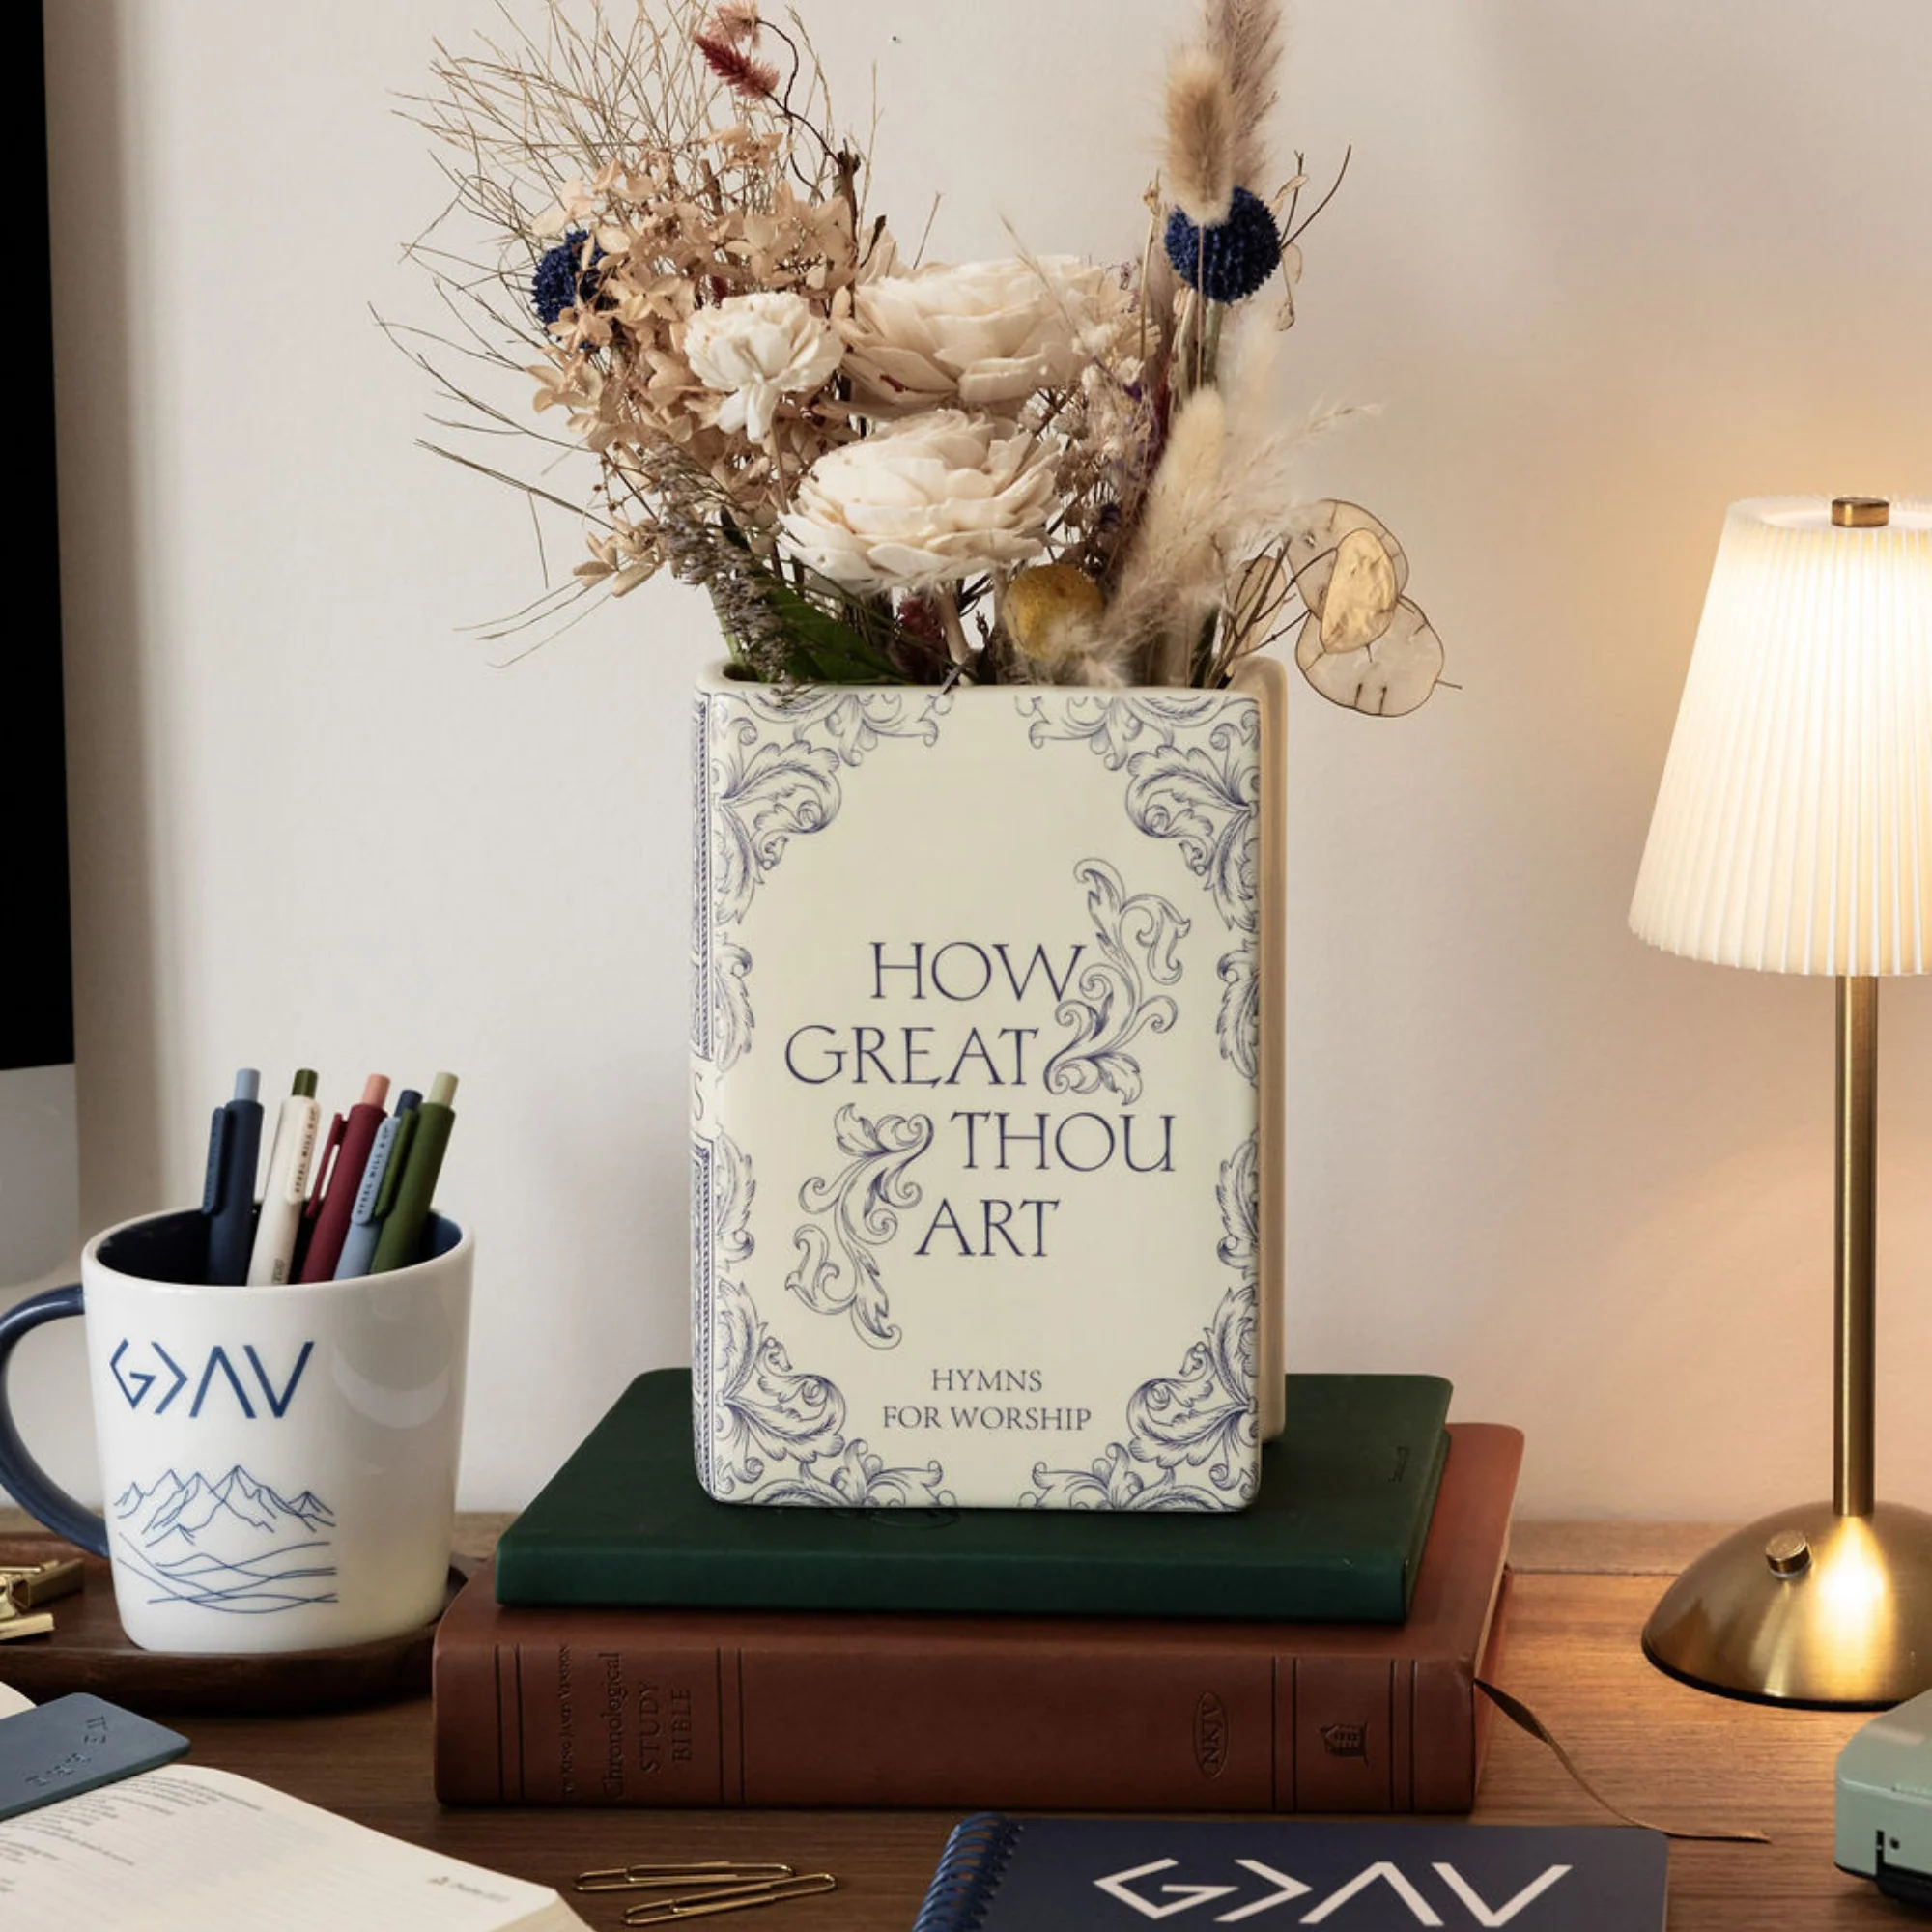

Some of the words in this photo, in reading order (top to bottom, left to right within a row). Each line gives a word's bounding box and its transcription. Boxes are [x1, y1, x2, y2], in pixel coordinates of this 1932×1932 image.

[870, 941, 1086, 1003] HOW
[784, 1024, 1040, 1089] GREAT
[951, 1111, 1176, 1173] THOU
[913, 1197, 1060, 1258] ART
[933, 1368, 1043, 1393] HYMNS
[883, 1406, 943, 1430] FOR
[949, 1406, 1092, 1431] WORSHIP
[599, 1652, 628, 1799] Chronological
[639, 1680, 661, 1774] STUDY
[671, 1689, 693, 1762] BIBLE
[1202, 1699, 1224, 1766] NKJV
